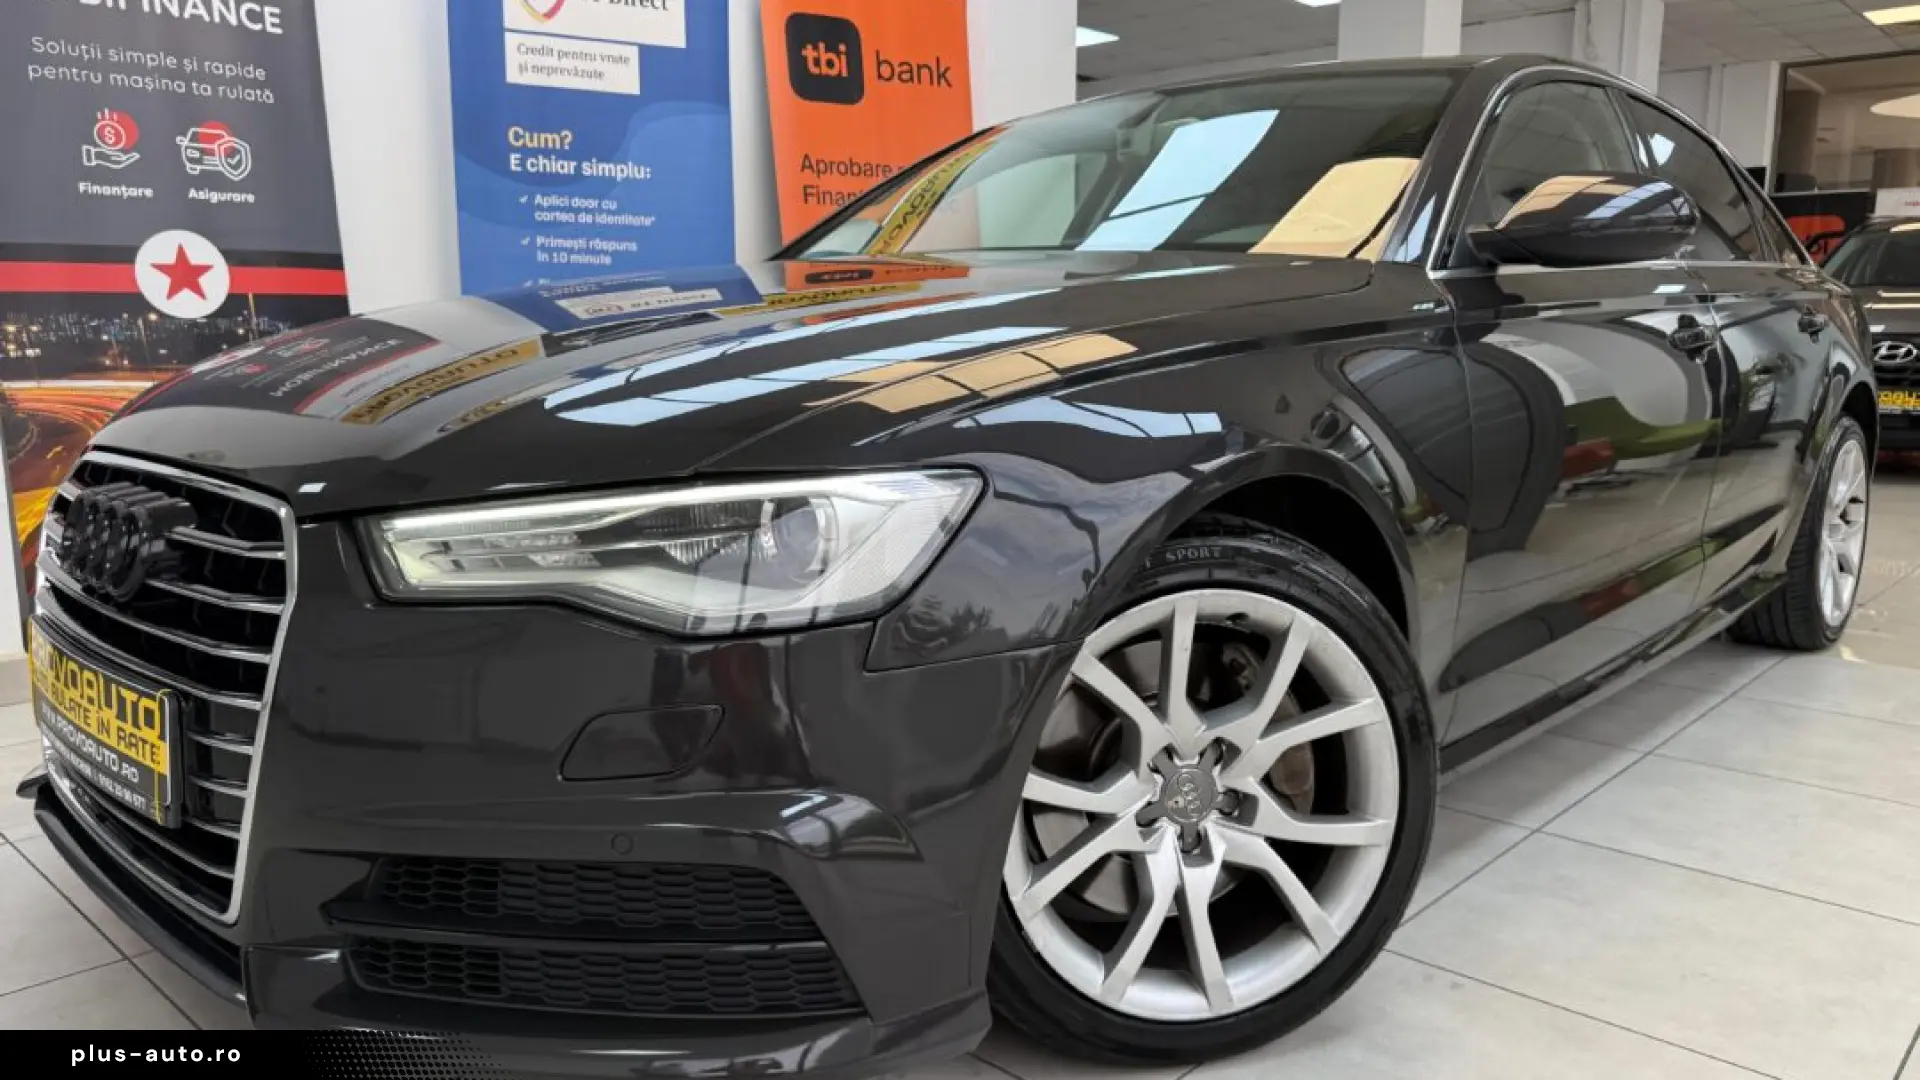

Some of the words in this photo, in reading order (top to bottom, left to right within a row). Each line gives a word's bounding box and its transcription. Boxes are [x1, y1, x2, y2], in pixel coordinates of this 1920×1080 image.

[31, 36, 102, 61] Soluții
[108, 48, 178, 69] simple
[183, 57, 198, 73] și
[204, 60, 266, 81] rapide
[516, 42, 555, 58] Credit
[557, 49, 597, 63] pentru
[801, 42, 849, 77] tbi
[875, 50, 953, 88] bank
[27, 63, 102, 84] pentru
[109, 72, 186, 93] mașina
[192, 81, 212, 96] ta
[218, 84, 275, 104] rulată
[507, 125, 573, 151] Cum?
[510, 153, 522, 172] E
[526, 155, 577, 176] chiar
[582, 160, 652, 181] simplu:
[800, 153, 893, 179] Aprobare
[78, 181, 154, 199] Finanțare
[187, 187, 255, 203] Asigurare
[535, 193, 569, 209] Aplici
[571, 197, 599, 209] doar
[601, 199, 618, 210] cu
[534, 211, 575, 223] cartea
[577, 211, 593, 224] de
[552, 252, 568, 263] 10
[570, 253, 612, 265] minute
[1165, 547, 1222, 561] SPORT
[117, 724, 161, 764] RATE
